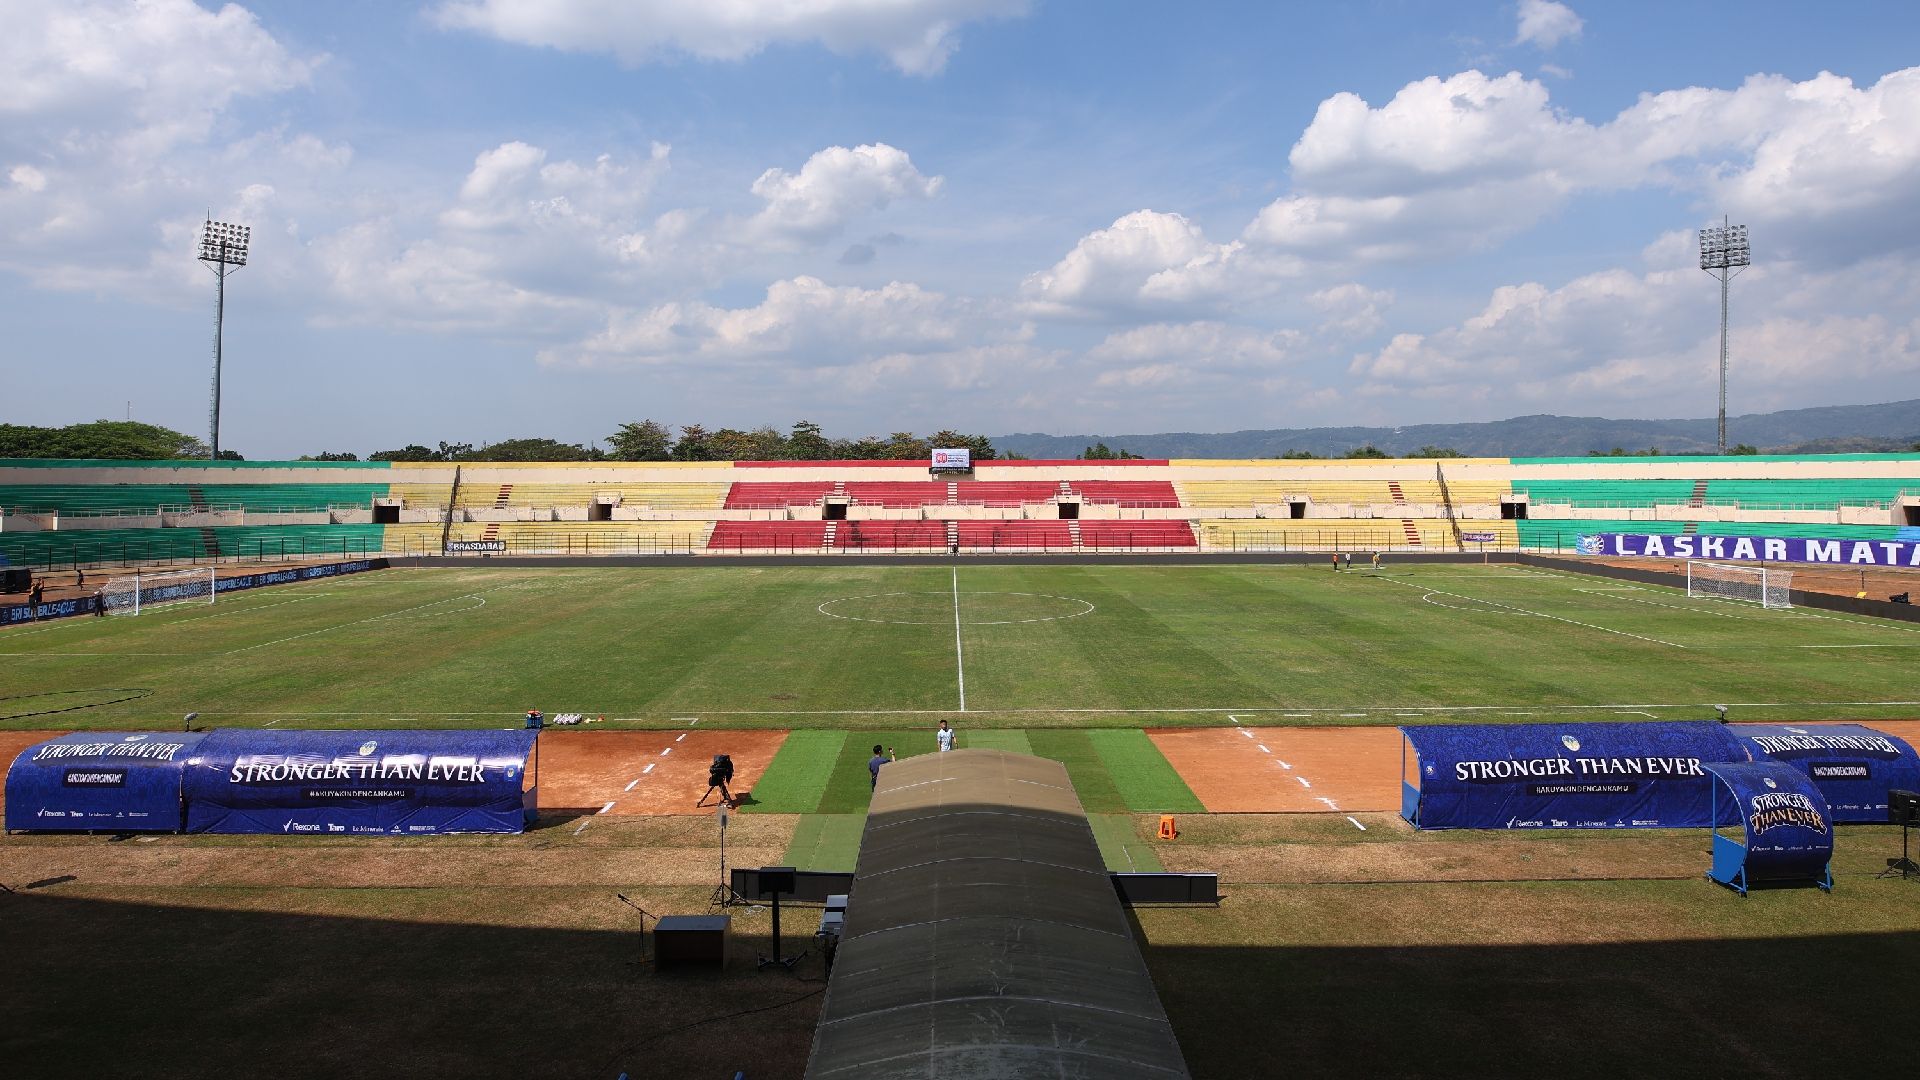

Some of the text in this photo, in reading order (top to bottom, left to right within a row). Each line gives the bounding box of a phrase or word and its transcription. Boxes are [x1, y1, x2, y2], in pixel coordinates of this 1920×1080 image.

[1615, 535, 1787, 560] LASKAR
[229, 763, 485, 783] STRONGER THAN EVER
[1455, 757, 1705, 780] STRONGER THAN EVER
[1753, 793, 1816, 815] STRONGER
[292, 822, 320, 831] Rexona
[328, 823, 345, 832] Taro
[1551, 819, 1568, 827] Taro
[1752, 808, 1825, 831] THAN EVER
